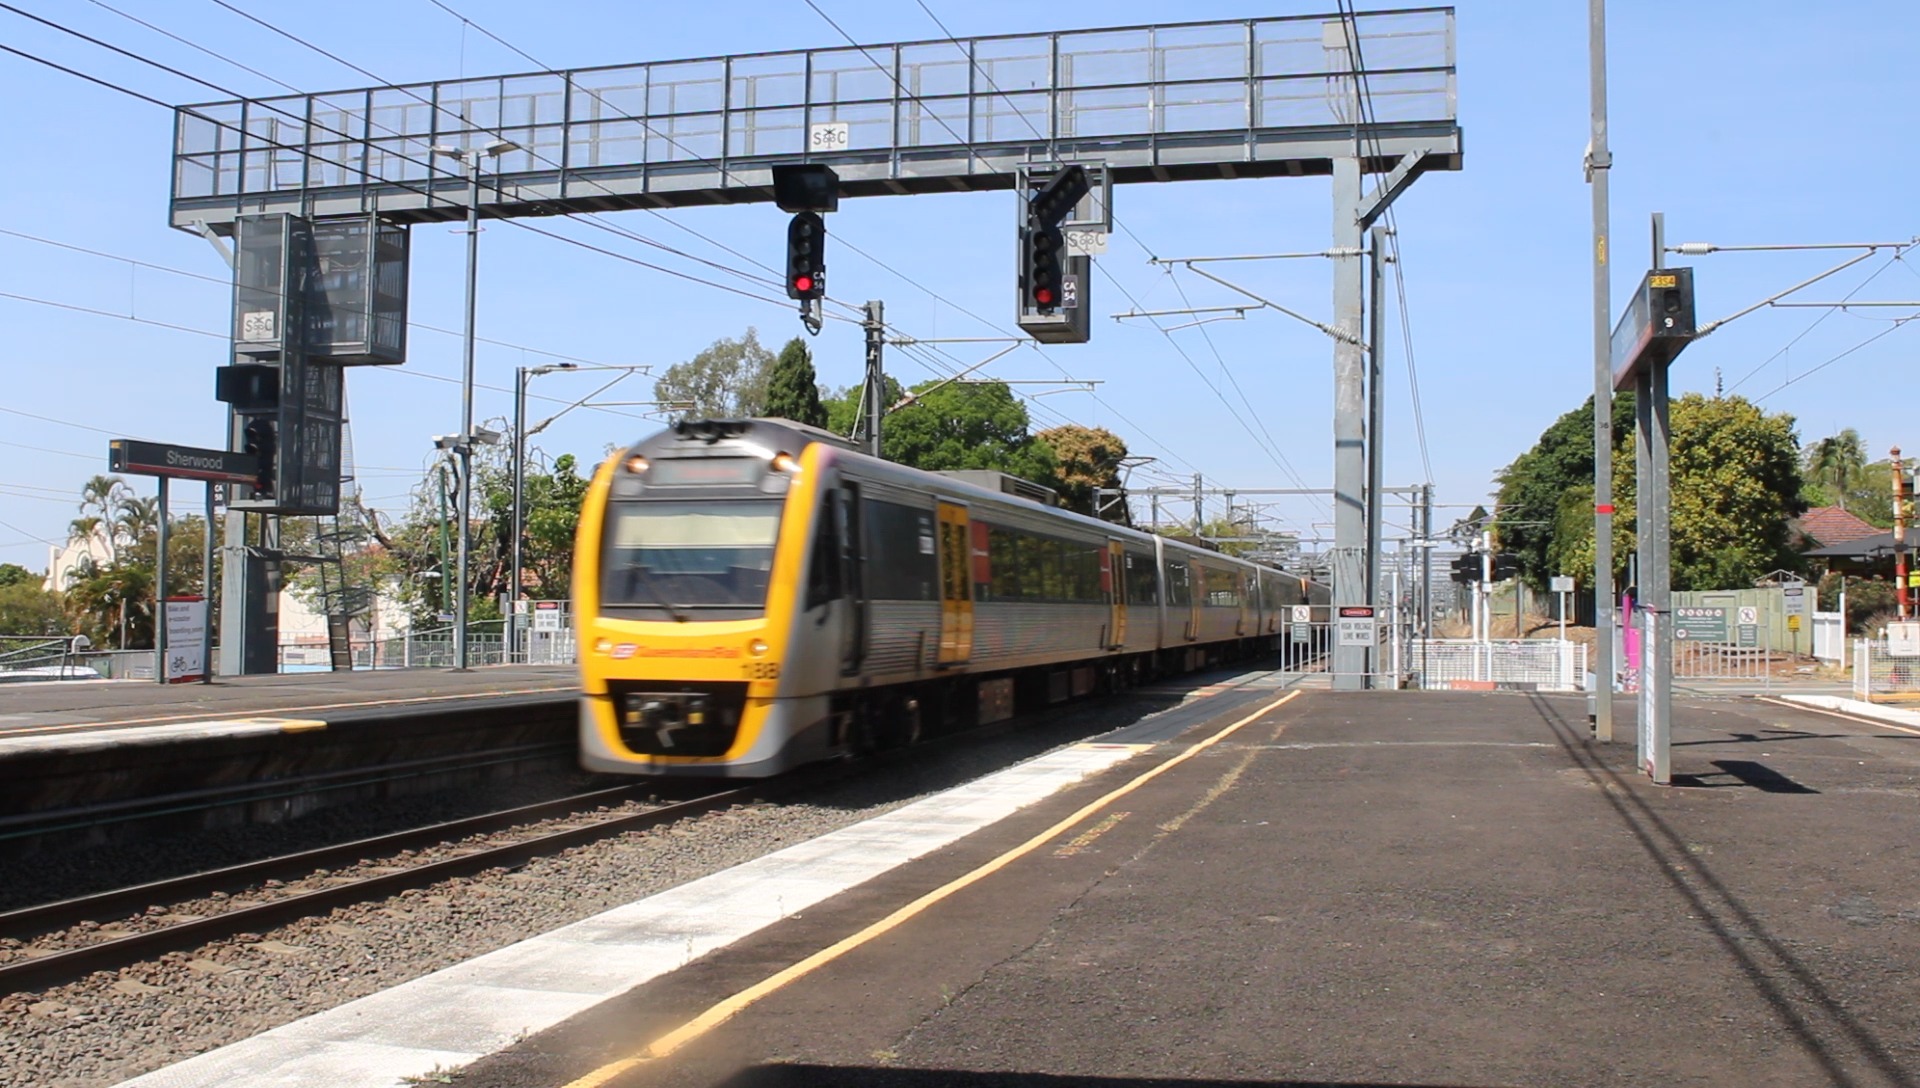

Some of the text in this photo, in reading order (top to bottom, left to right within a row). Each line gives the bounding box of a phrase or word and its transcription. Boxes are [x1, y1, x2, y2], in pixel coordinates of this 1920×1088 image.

[1063, 282, 1076, 291] CA
[1064, 291, 1075, 301] 54
[1664, 317, 1674, 328] 9
[166, 450, 223, 470] Sherwood
